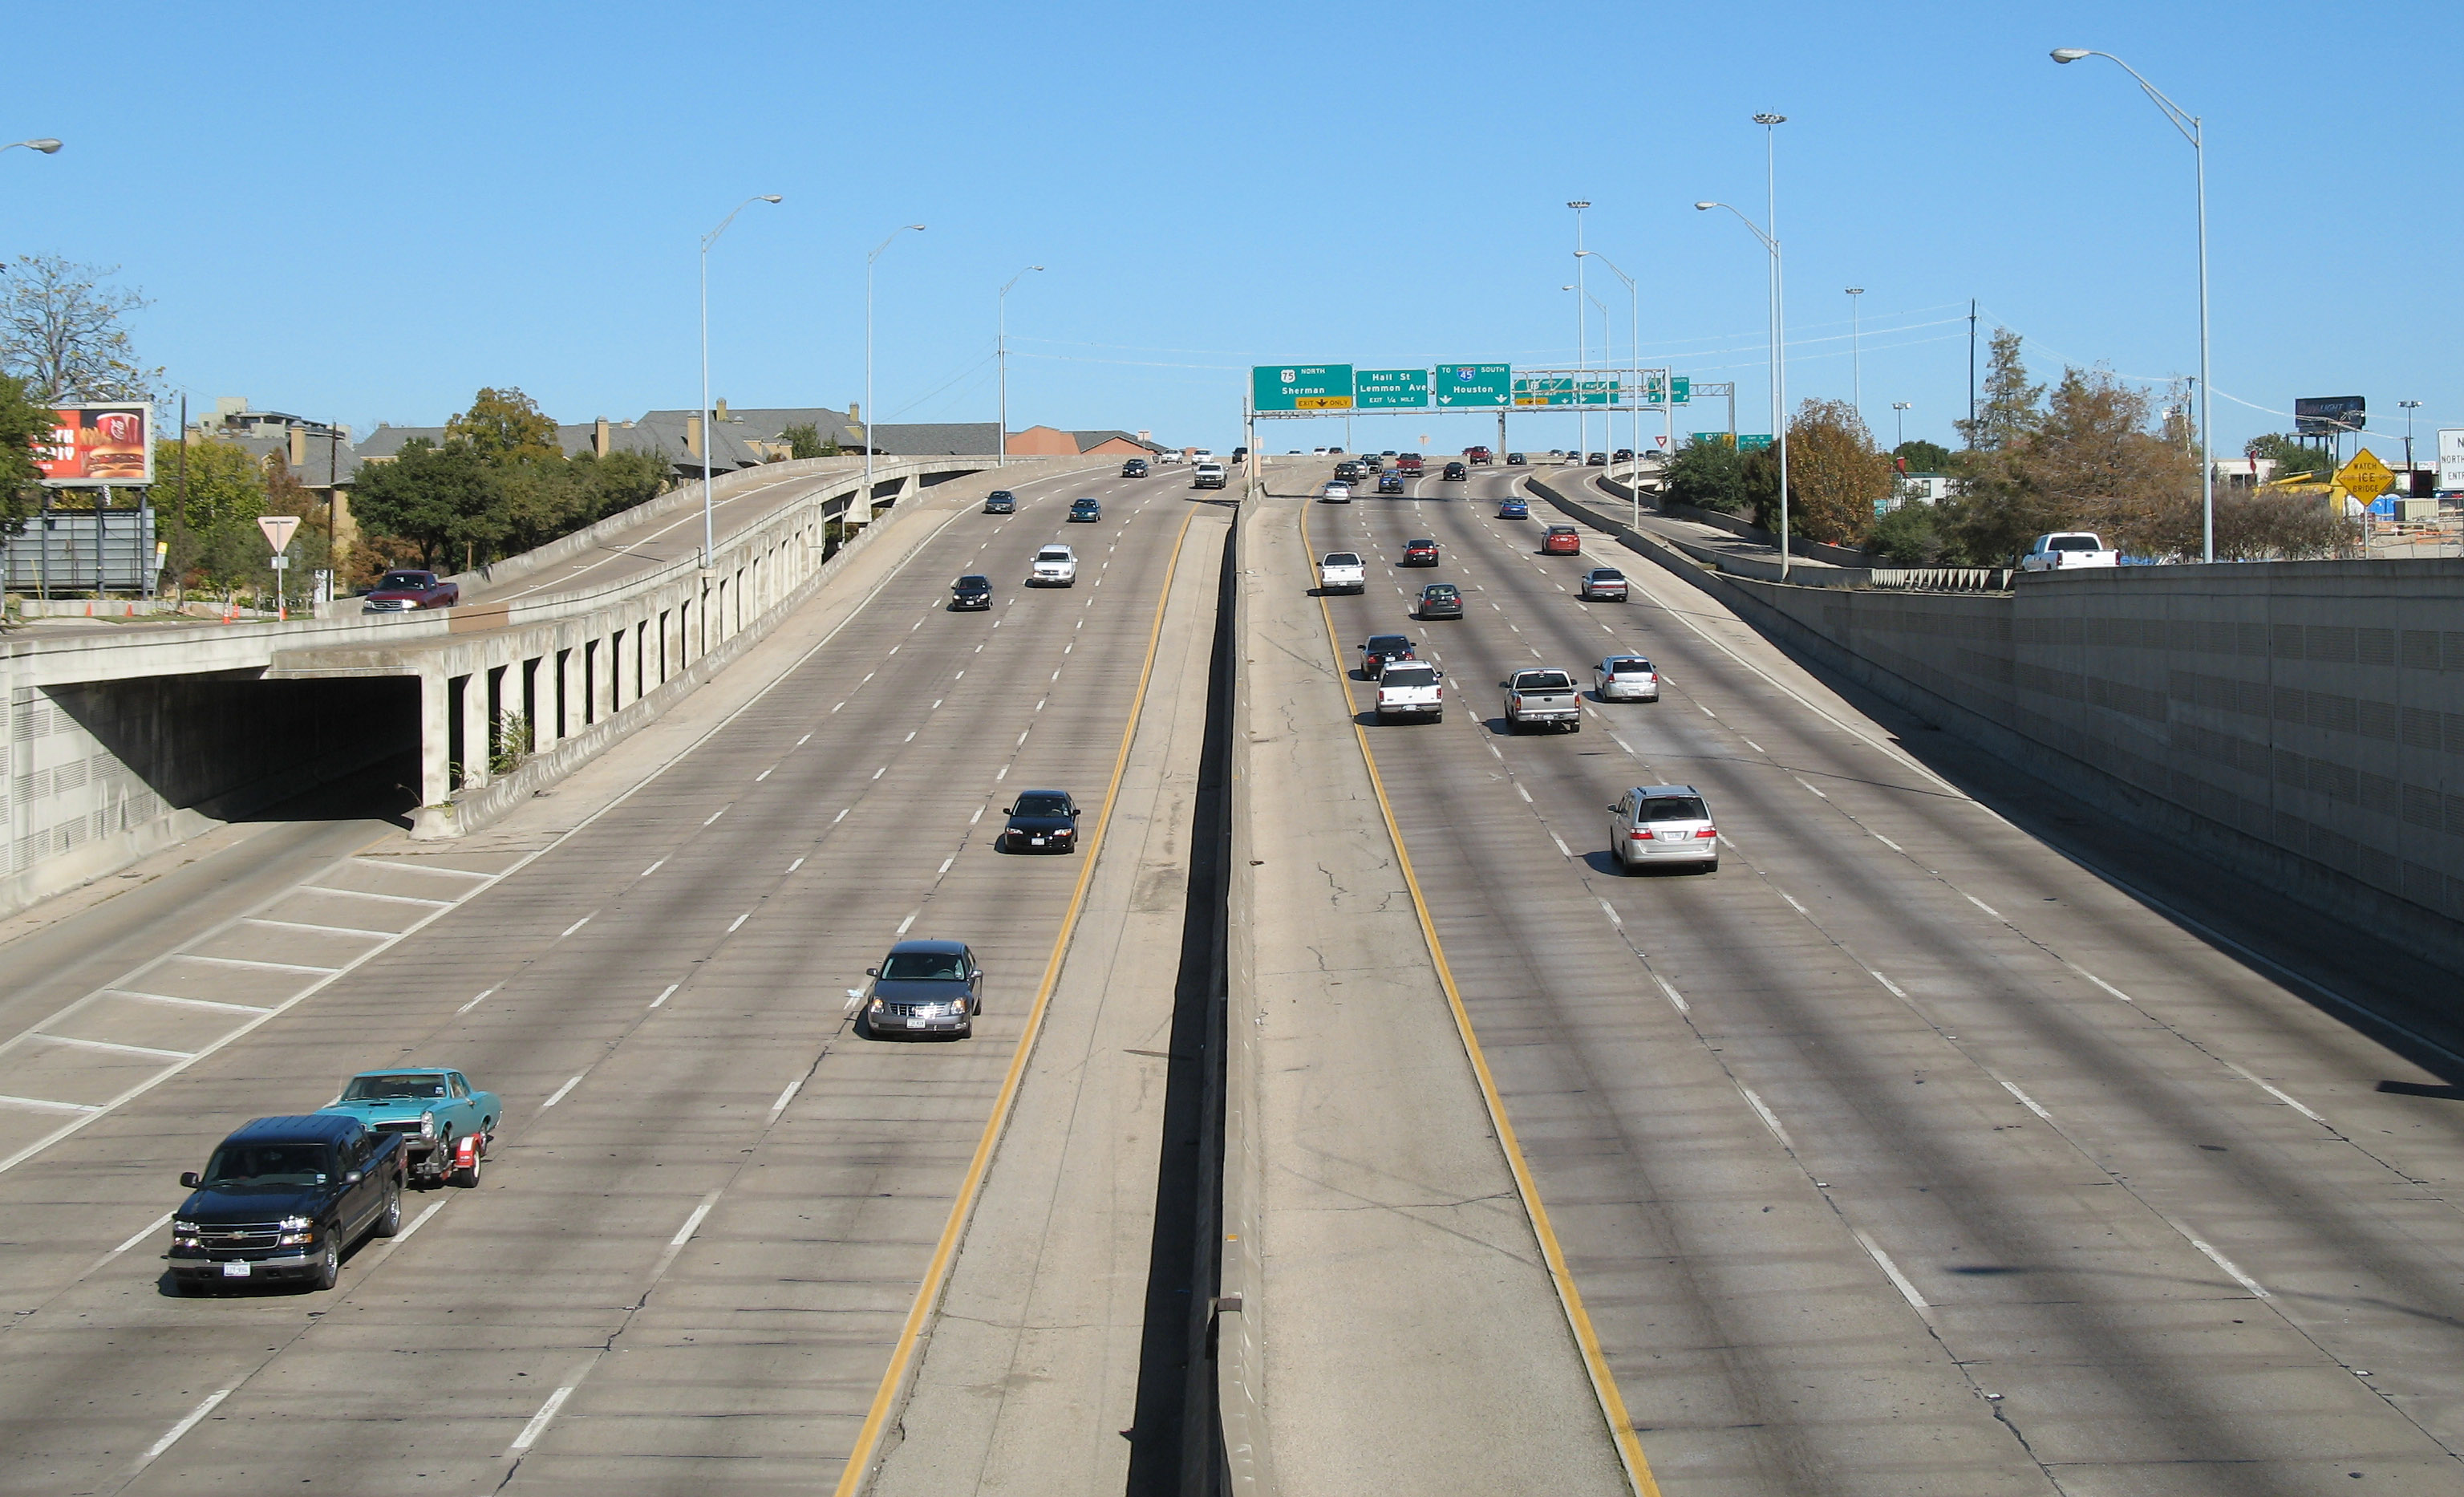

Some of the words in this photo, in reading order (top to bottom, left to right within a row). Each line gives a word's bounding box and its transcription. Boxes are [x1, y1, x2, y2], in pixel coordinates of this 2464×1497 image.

[1283, 372, 1294, 380] 75
[1372, 373, 1392, 381] Hall
[1460, 371, 1473, 379] 45
[1408, 383, 1427, 391] Ave
[2320, 404, 2344, 412] LIGHT
[2353, 462, 2377, 470] WATCH
[2358, 473, 2375, 482] ICE
[2353, 485, 2379, 493] BRIDGE
